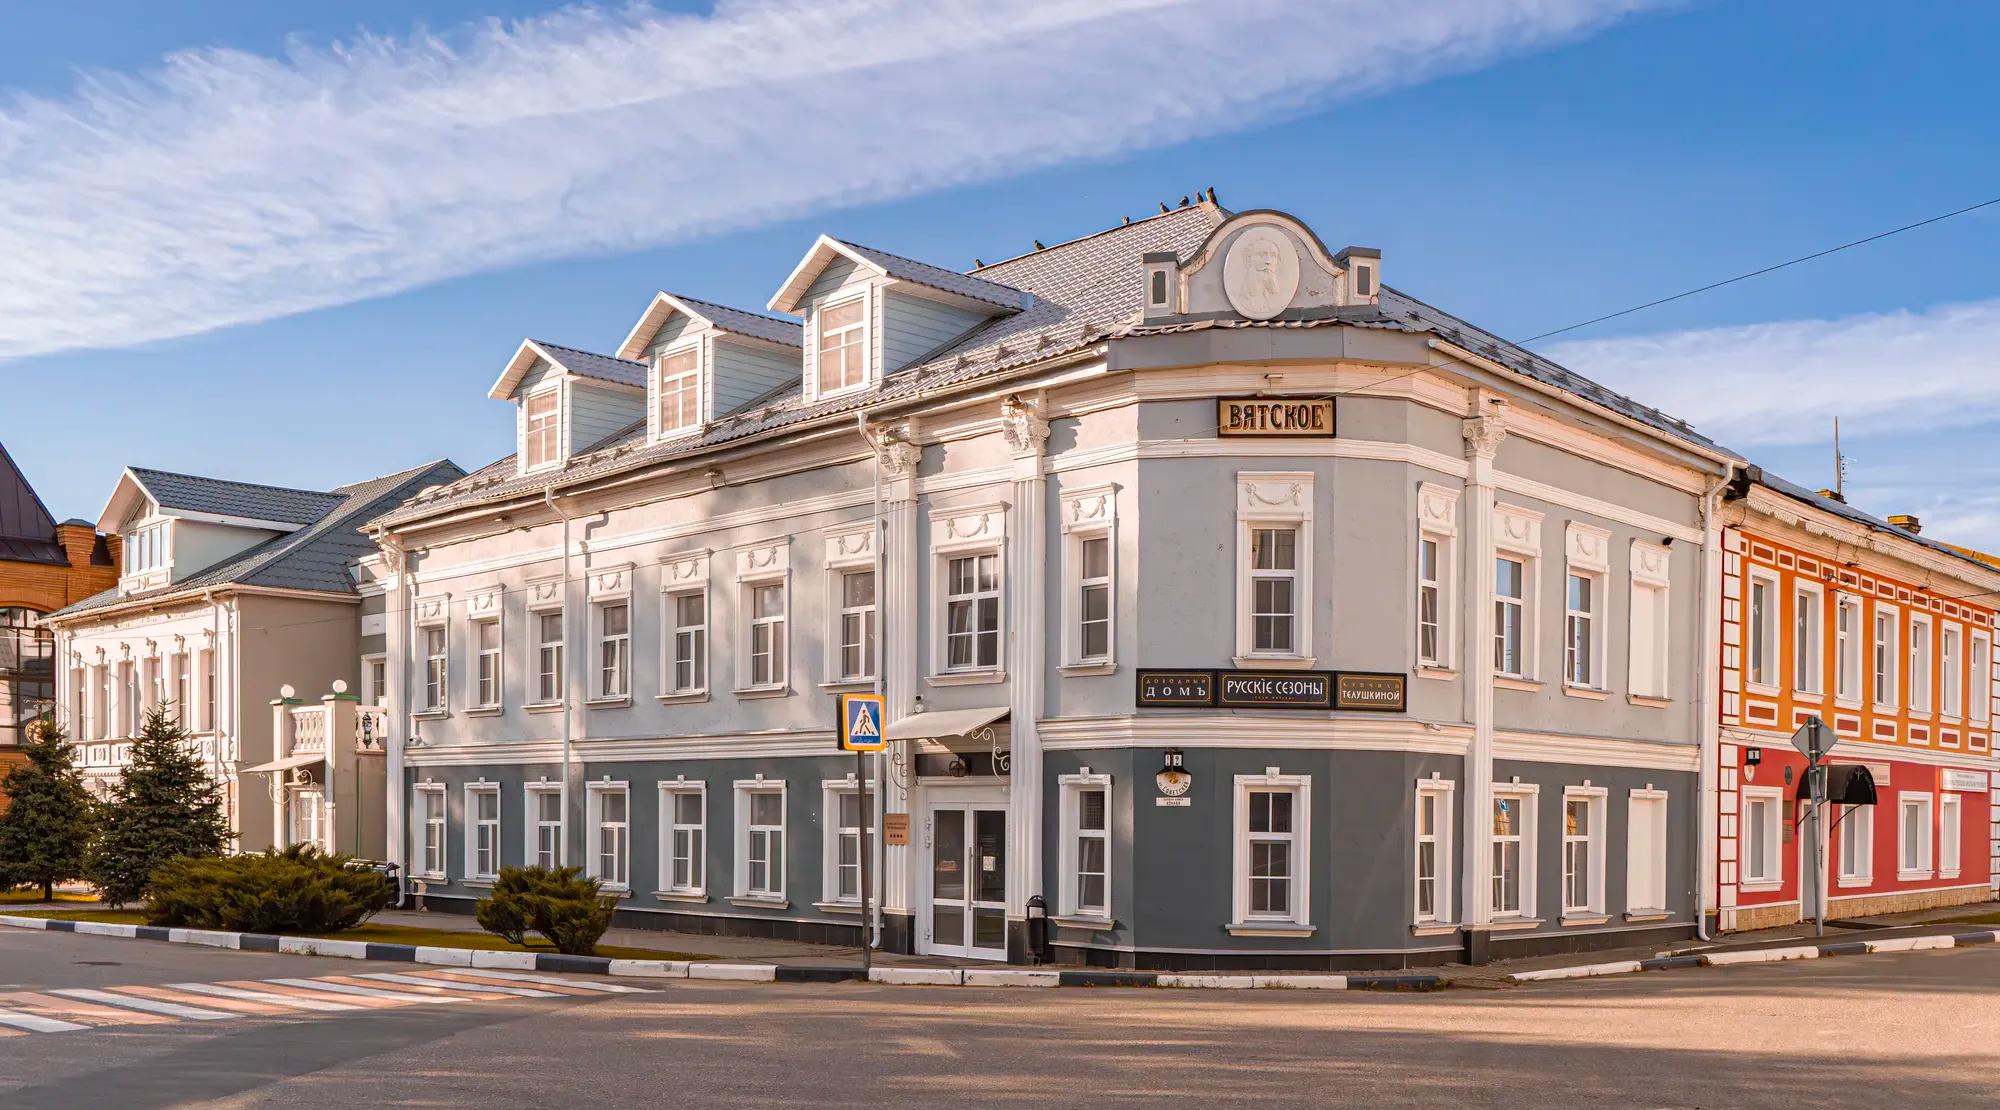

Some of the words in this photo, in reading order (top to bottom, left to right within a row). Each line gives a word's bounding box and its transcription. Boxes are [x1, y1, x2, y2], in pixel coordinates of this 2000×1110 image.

[1146, 686, 1206, 698] ДОМЪ
[1275, 681, 1323, 695] СЕЗОНЫ
[1342, 690, 1400, 701] ТЕЛУШКИНОЙ
